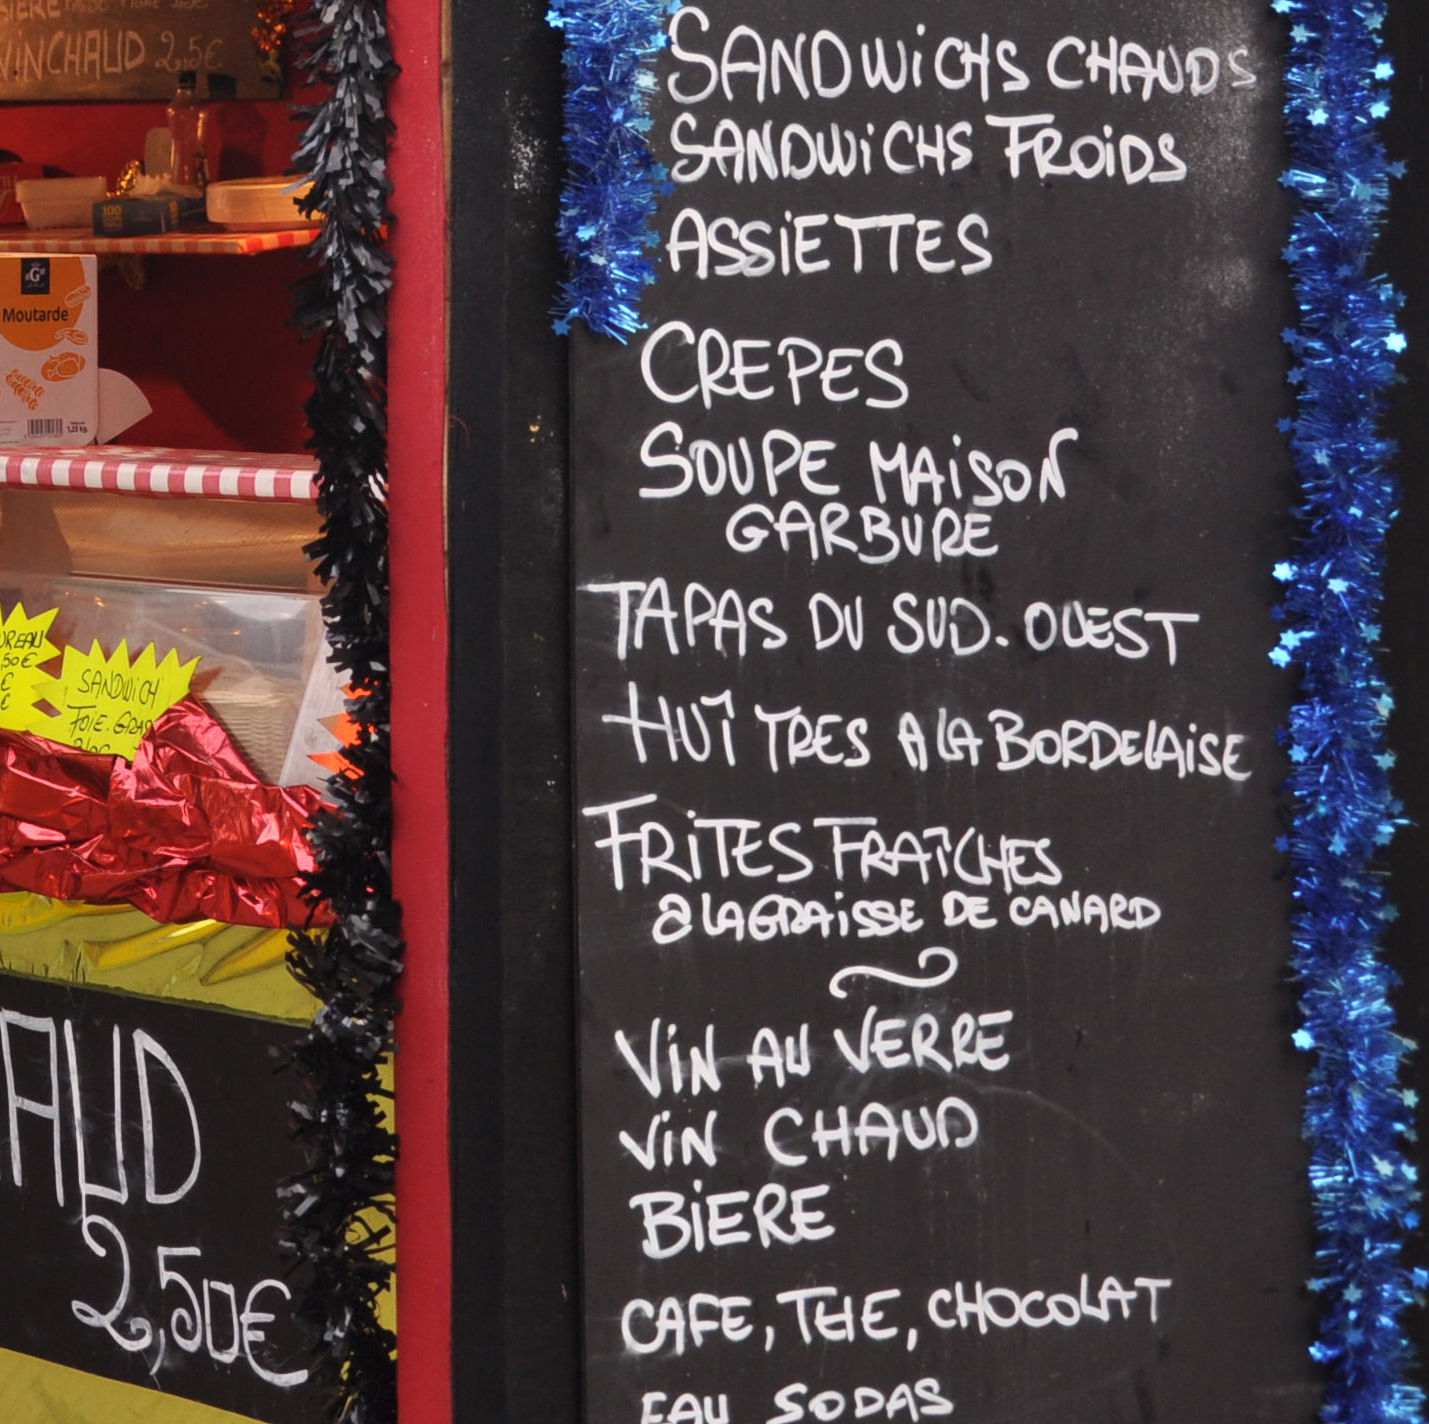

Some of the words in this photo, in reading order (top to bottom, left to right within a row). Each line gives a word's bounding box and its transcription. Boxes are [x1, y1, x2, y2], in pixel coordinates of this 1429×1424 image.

[46, 30, 146, 80] CHAUD
[1046, 35, 1257, 103] CHAUDS
[2, 306, 69, 324] Moutarde
[640, 319, 910, 410] CREPES
[639, 420, 841, 499] SOUPE
[725, 500, 999, 565] GARBURE
[576, 577, 789, 662] TAPAS
[809, 591, 863, 651] DU
[942, 890, 998, 931] DE
[1008, 890, 1162, 935] CANARD
[746, 1022, 810, 1089] AU
[833, 1004, 1014, 1074] VERRE
[763, 1096, 979, 1167] CHAUD
[71, 1214, 309, 1387] 2,50€
[928, 1273, 1173, 1335] CHOCOLAT
[765, 1377, 955, 1424] SODAS
